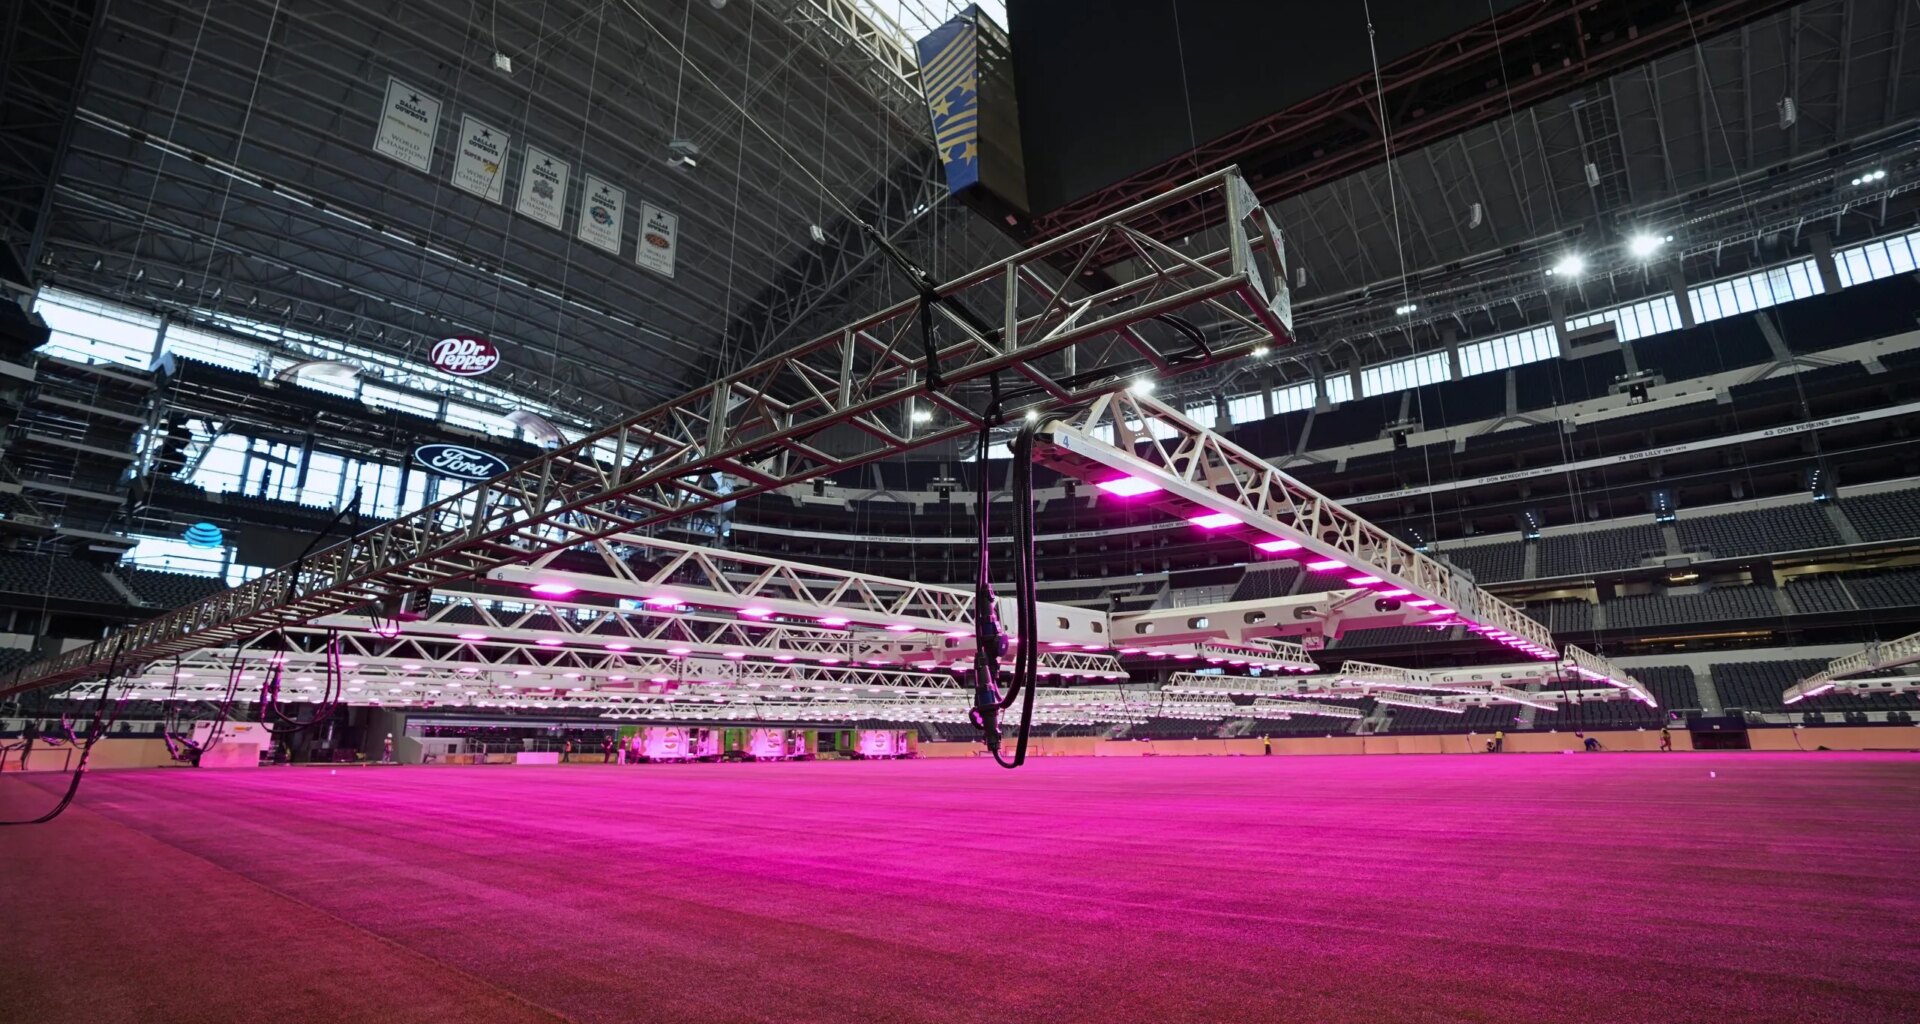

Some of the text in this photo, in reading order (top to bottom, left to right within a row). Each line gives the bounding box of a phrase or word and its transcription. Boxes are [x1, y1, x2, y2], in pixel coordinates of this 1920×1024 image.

[395, 103, 428, 123] COWBOYS
[400, 99, 426, 116] DALLAS
[380, 136, 427, 161] CHAMPIONS
[391, 133, 420, 151] WORLD
[469, 139, 499, 157] COWBOYS
[473, 135, 497, 150] DALLAS
[532, 168, 560, 185] COWBOYS
[536, 164, 558, 178] DALLAS
[591, 196, 616, 211] COWBOYS
[594, 192, 615, 205] DALLAS
[647, 222, 670, 236] COWBOYS
[650, 218, 669, 230] DALLAS
[431, 338, 495, 370] Pepper
[458, 339, 486, 356] Dr
[1763, 429, 1774, 437] 43
[1777, 426, 1795, 435] DON
[1796, 420, 1830, 431] PERKINS
[1062, 435, 1070, 448] 4
[432, 448, 494, 476] Ford
[1629, 452, 1644, 460] BOB
[1645, 449, 1662, 457] LILLY
[1500, 471, 1529, 481] MEREDITH
[497, 572, 504, 580] 6
